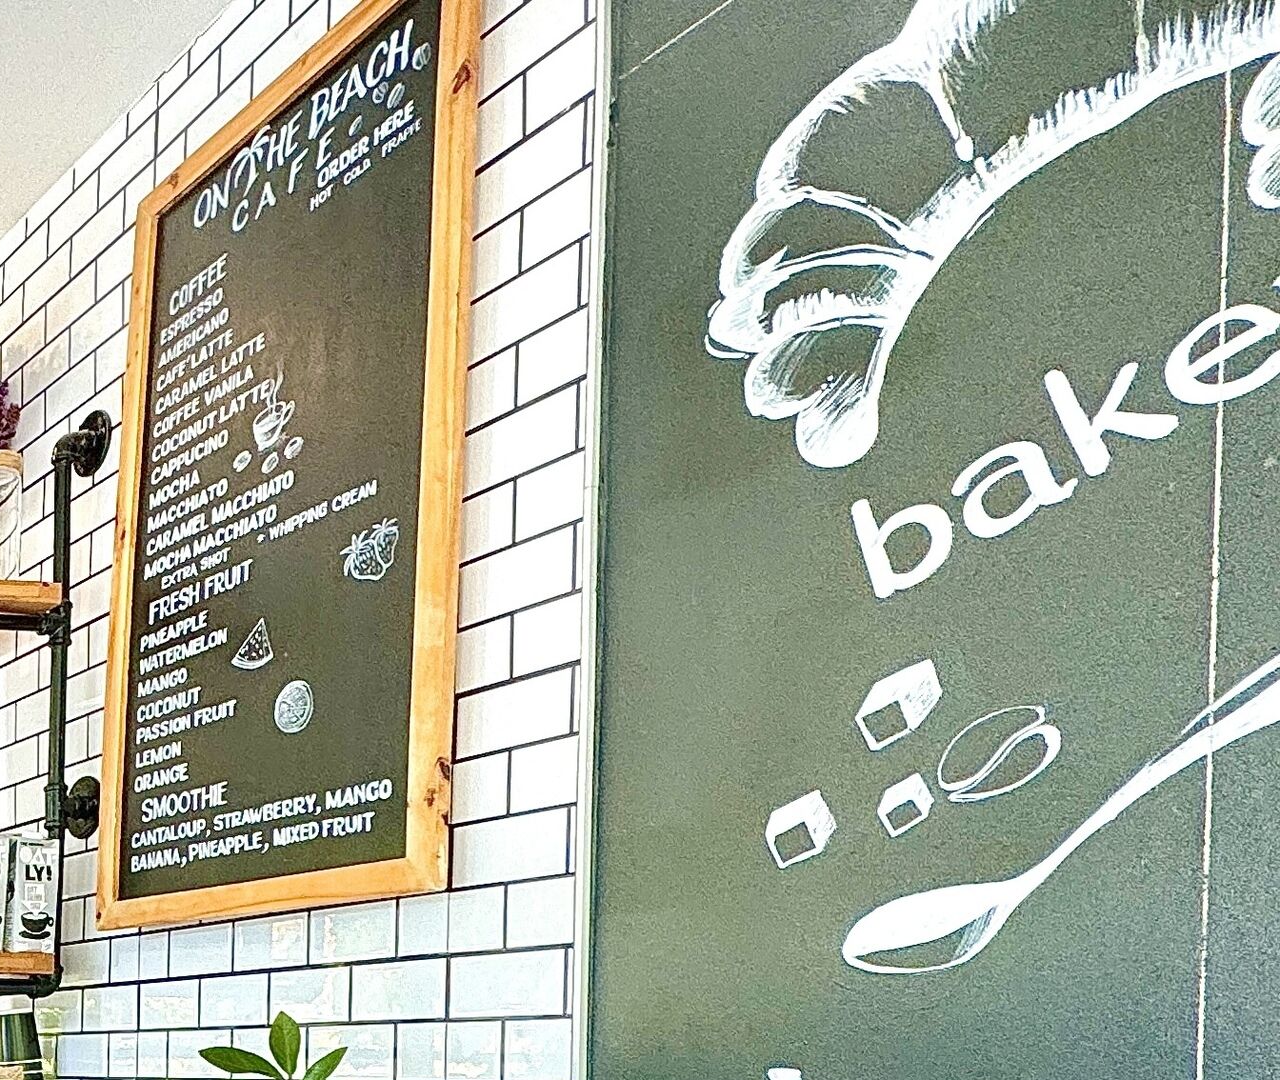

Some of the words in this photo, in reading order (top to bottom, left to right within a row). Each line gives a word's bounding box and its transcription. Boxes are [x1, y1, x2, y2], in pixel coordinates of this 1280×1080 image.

[193, 168, 230, 228] ON
[308, 19, 414, 140] BEACH
[317, 136, 370, 188] ORDER
[373, 100, 415, 147] HERE
[232, 127, 335, 232] CAFE
[309, 184, 334, 212] HOT
[343, 158, 372, 186] COLD
[169, 253, 229, 316] COFFEE
[157, 308, 229, 368] AMERICANO
[160, 287, 224, 346] ESPRESSO
[155, 362, 218, 415] CARAMEL
[221, 333, 265, 373] LATTE
[190, 328, 234, 373] LATTE
[151, 411, 219, 462] COCONUT
[218, 380, 271, 424] LATTE
[153, 392, 201, 439] COFFEE
[204, 365, 254, 407] VANILA
[150, 430, 229, 486] CAPPUCINO
[851, 303, 1280, 599] bake
[146, 512, 209, 556] CARAMEL
[211, 469, 295, 525] MACCHIATO
[147, 478, 229, 534] MACCHIATO
[148, 469, 201, 510] MOCHA
[331, 480, 378, 512] CREAM
[143, 547, 192, 581] MOCHA
[191, 504, 278, 558] MACCHIATO
[160, 561, 199, 590] EXTRA
[200, 546, 231, 572] SHOT
[148, 587, 201, 625] FRESH
[203, 558, 253, 599] FRUIT
[138, 628, 228, 675] WATERMELON
[139, 610, 208, 653] PINEAPPLE
[136, 687, 201, 723] COCONUT
[137, 667, 188, 698] MANGO
[135, 716, 192, 745] PASSION
[192, 699, 237, 729] FRUIT
[133, 763, 189, 794] ORANGE
[134, 742, 183, 769] LEMON
[131, 819, 211, 850] CANTALOUP,
[212, 793, 322, 831] STRAWBERRY,
[324, 778, 393, 810] MANGO
[141, 781, 229, 823] SMOOTHIE
[130, 847, 188, 874] BANANA,
[188, 831, 271, 862] PINEAPPLE,
[271, 821, 320, 847] MIXED
[321, 811, 376, 838] FRUIT
[25, 864, 52, 881] LY!
